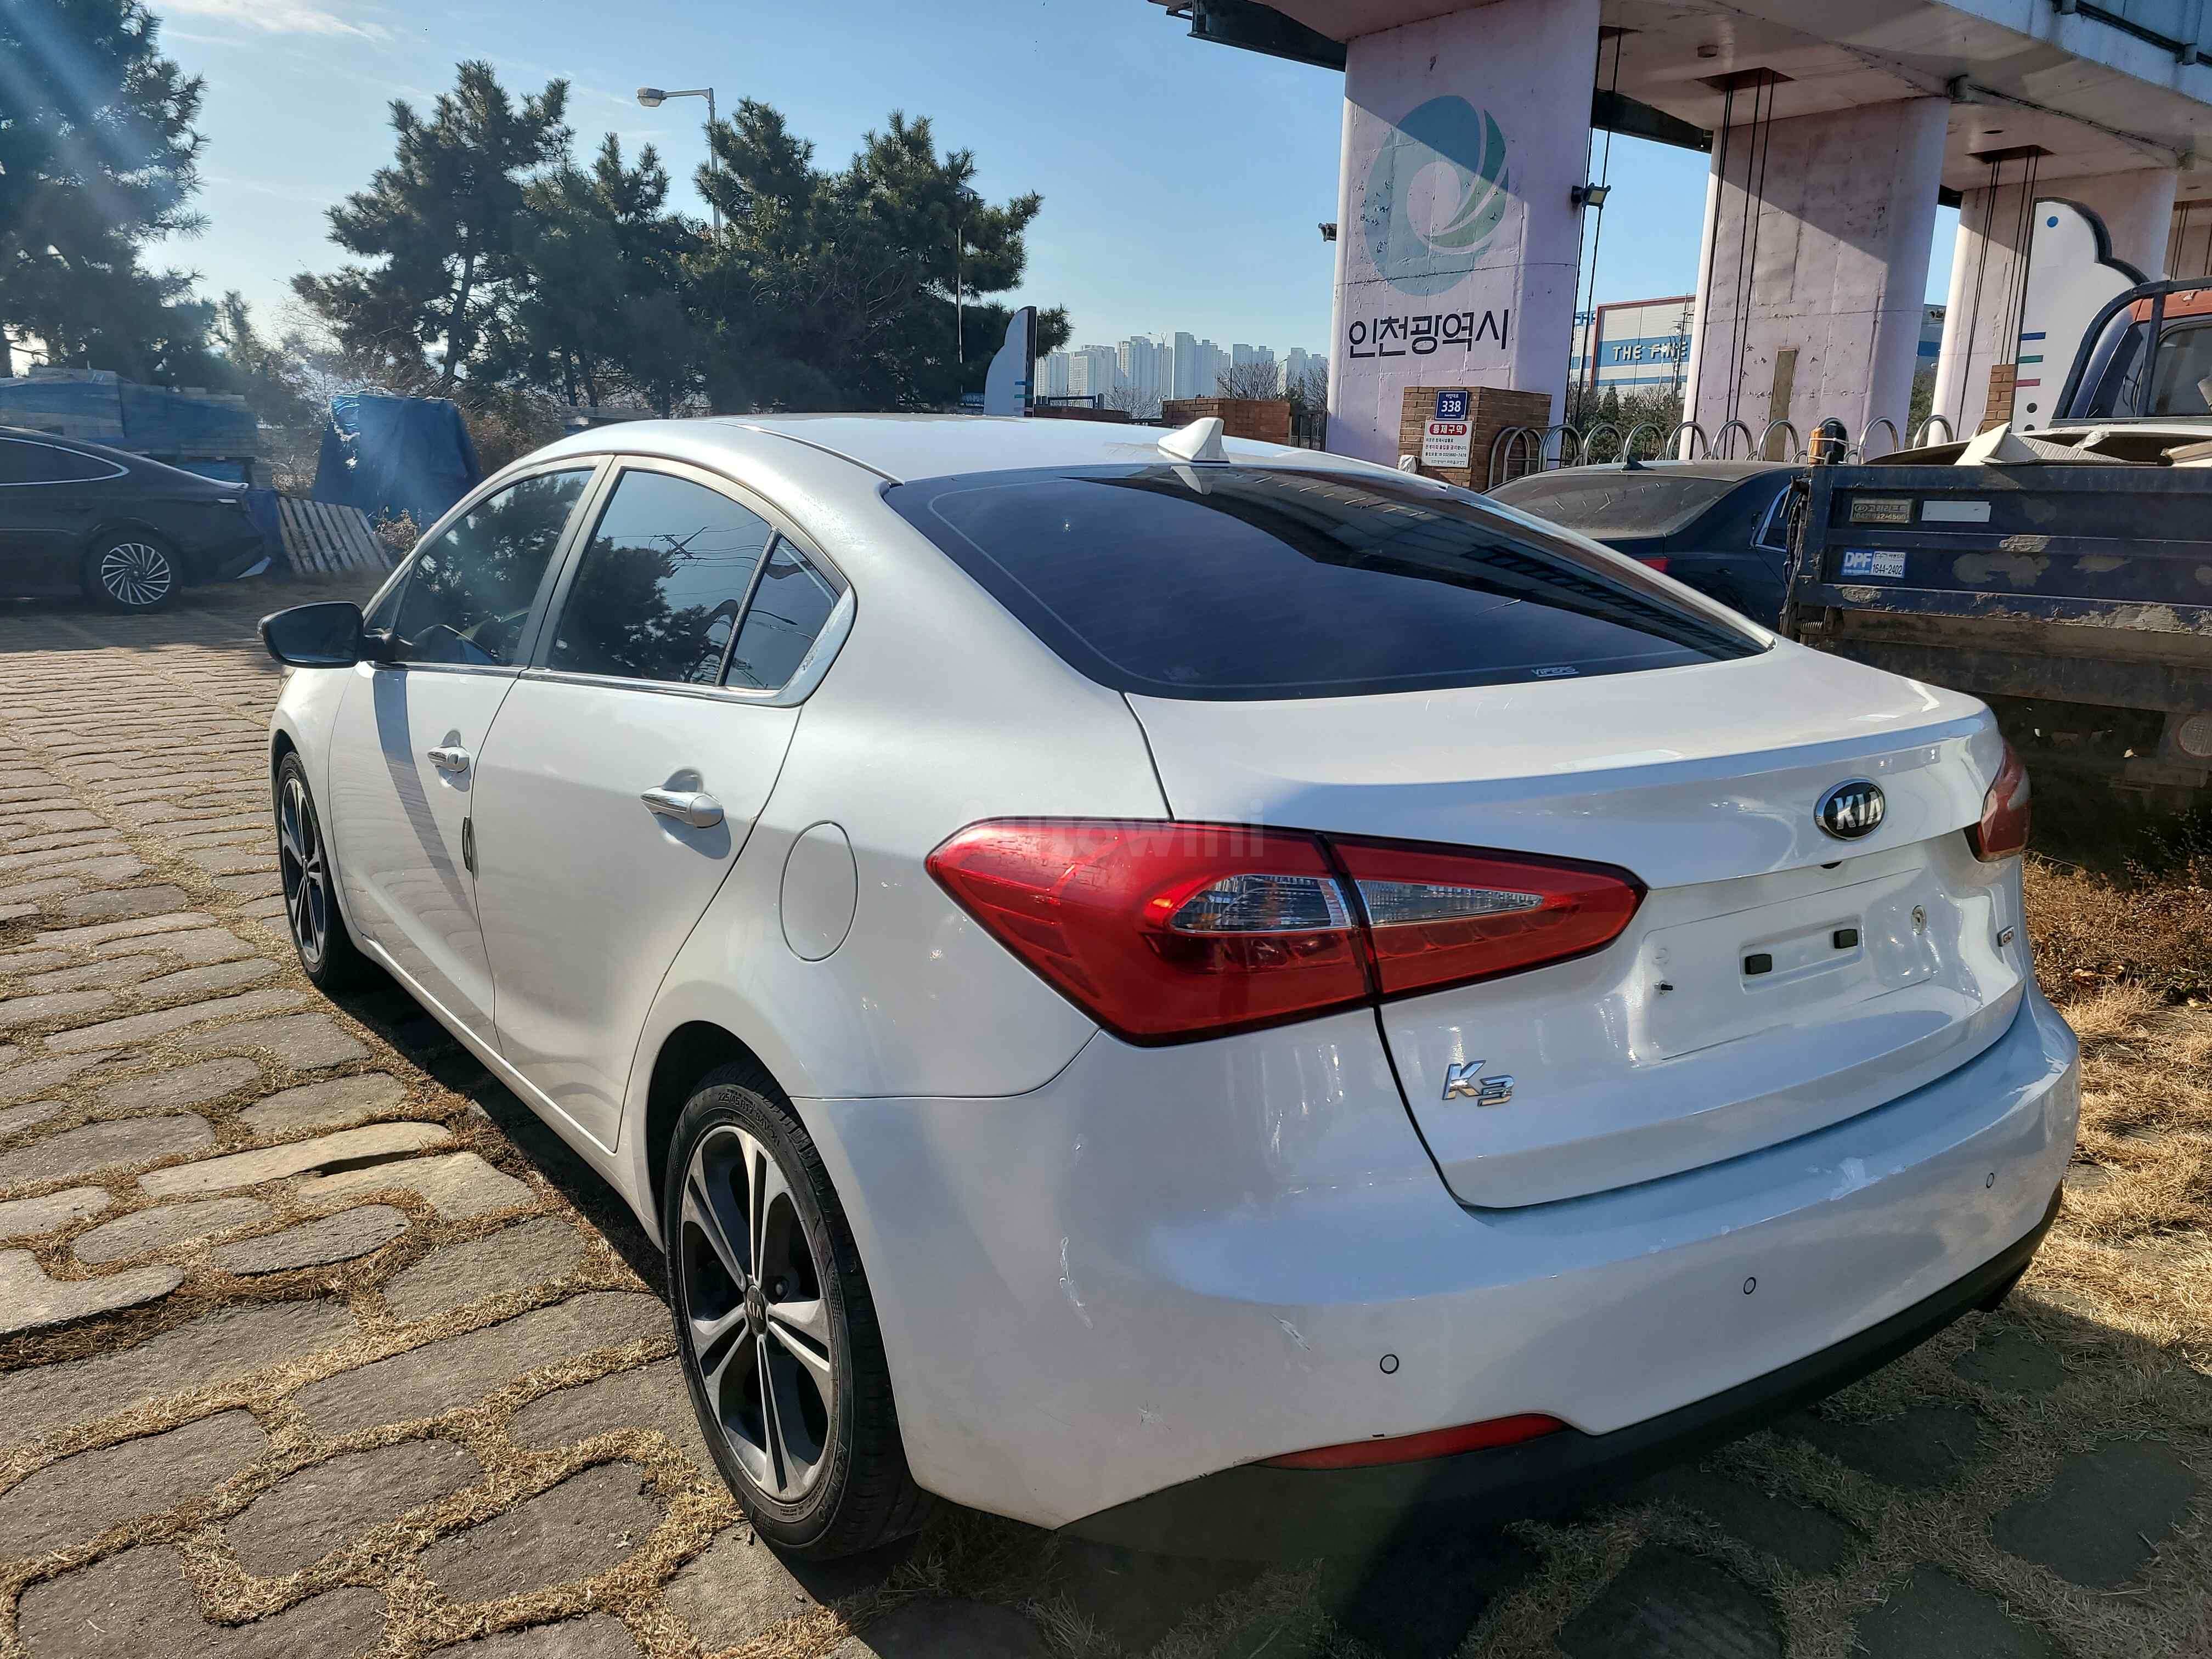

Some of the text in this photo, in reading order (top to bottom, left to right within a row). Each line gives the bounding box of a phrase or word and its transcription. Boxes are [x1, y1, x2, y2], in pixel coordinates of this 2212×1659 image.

[1348, 309, 1509, 358] 인천광역시
[1612, 345, 1643, 361] THE
[1441, 400, 1462, 413] 338
[1844, 552, 1872, 568] DPF
[1872, 563, 1903, 575] 1644-2402
[1833, 791, 1883, 830] KIA
[1442, 1059, 1515, 1107] K3
[747, 1299, 763, 1320] KIA
